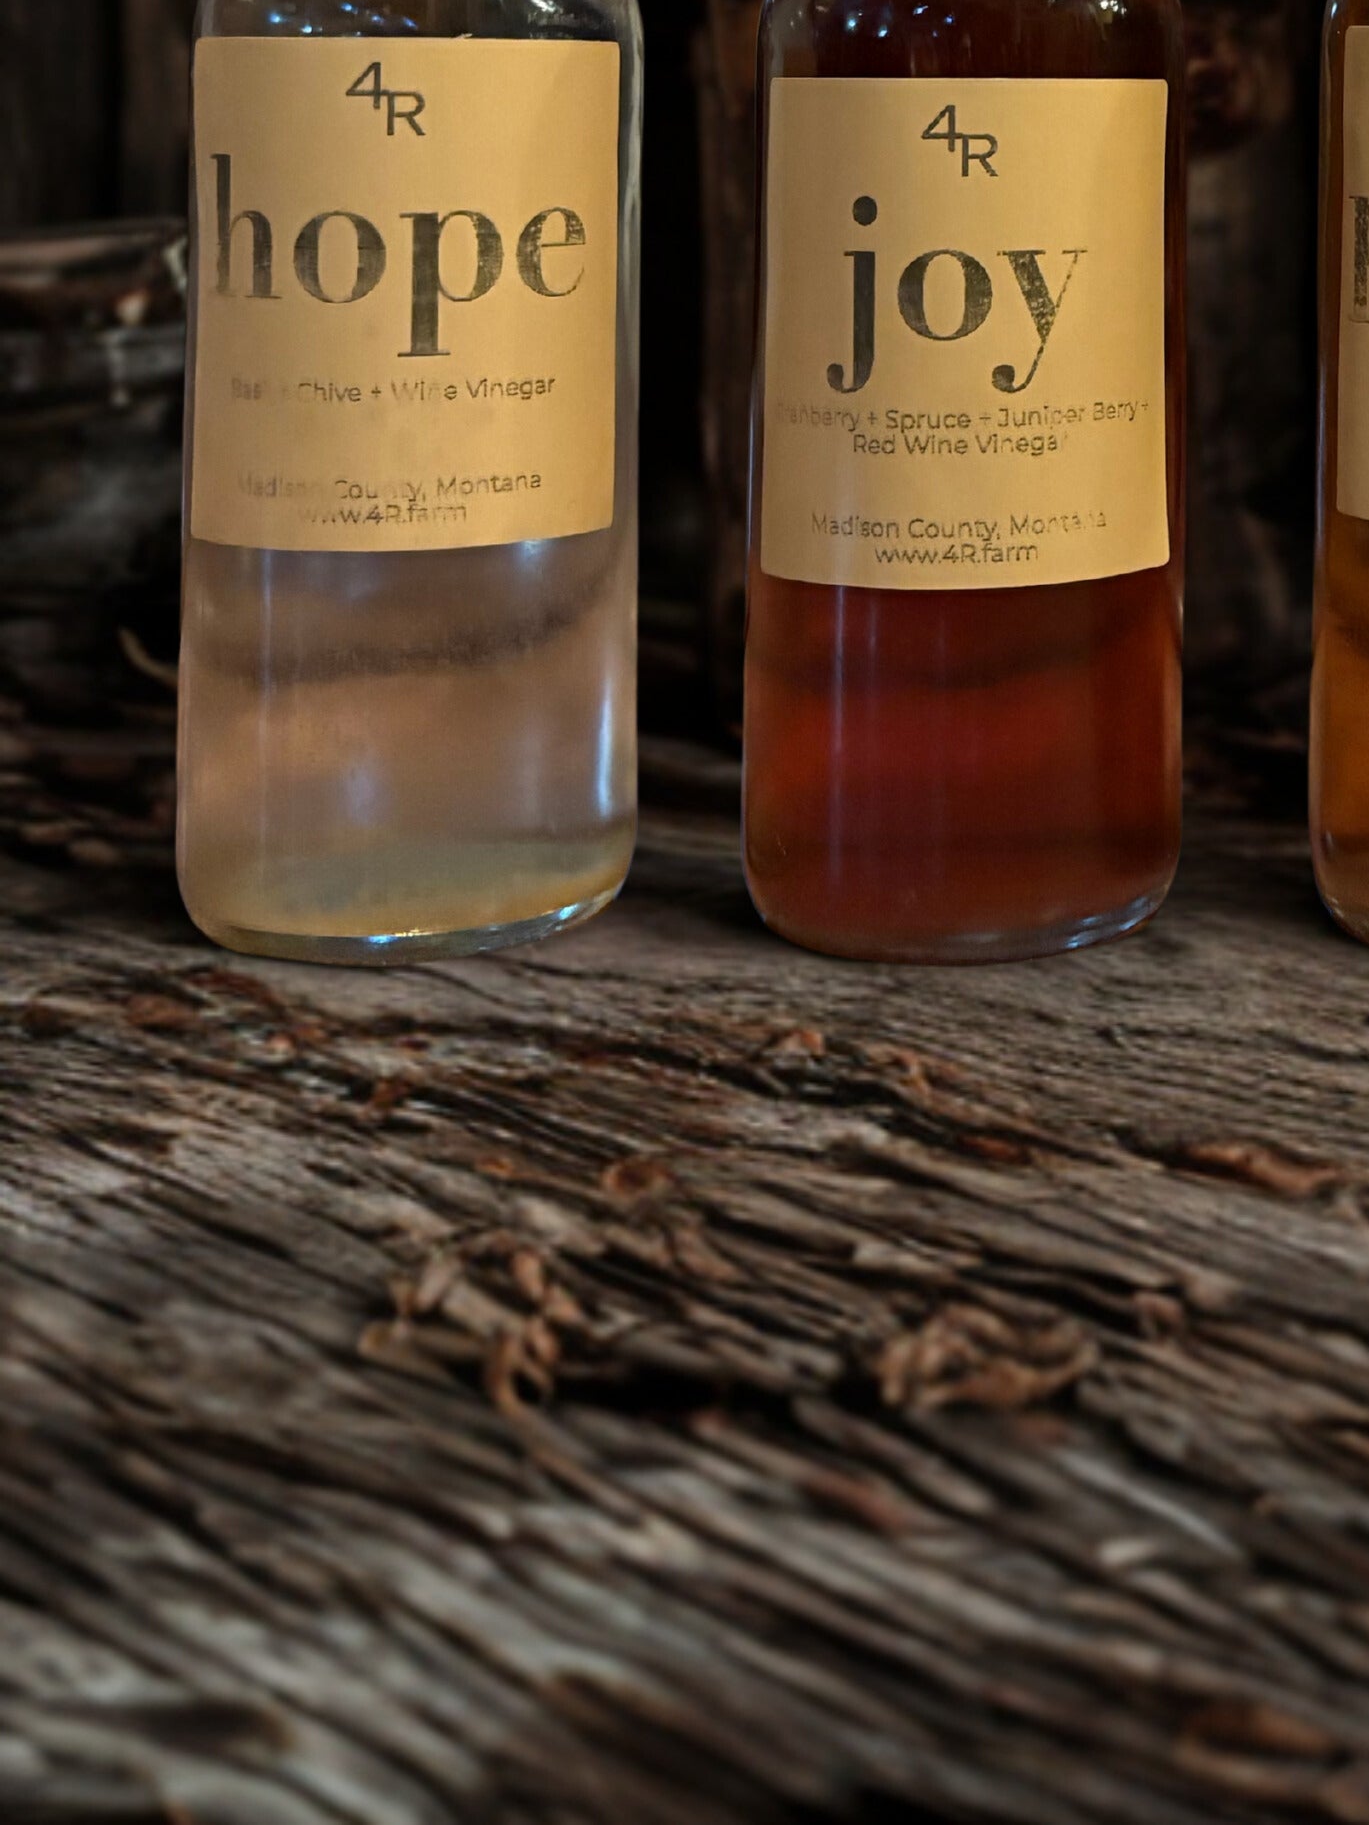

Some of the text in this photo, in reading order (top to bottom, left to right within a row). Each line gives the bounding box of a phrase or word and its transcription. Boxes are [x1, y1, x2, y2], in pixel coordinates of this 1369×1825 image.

[346, 62, 425, 136] 4R
[921, 105, 998, 177] 4R
[210, 154, 586, 357] hope
[827, 195, 1088, 394] joy
[371, 386, 382, 399] +
[466, 376, 556, 400] Vinegar
[776, 403, 860, 433] anberry
[868, 413, 878, 426] +
[886, 408, 971, 434] Spruce
[997, 406, 1085, 431] Juniper
[1093, 400, 1138, 422] Berry
[853, 433, 1067, 457] Red Wine Vinega
[334, 478, 426, 503] Couy,
[436, 471, 542, 497] Montana
[299, 504, 466, 526] w.4R.farm
[812, 512, 899, 538] Madison
[908, 517, 1000, 541] County,
[874, 542, 1040, 565] www.4R.farm
